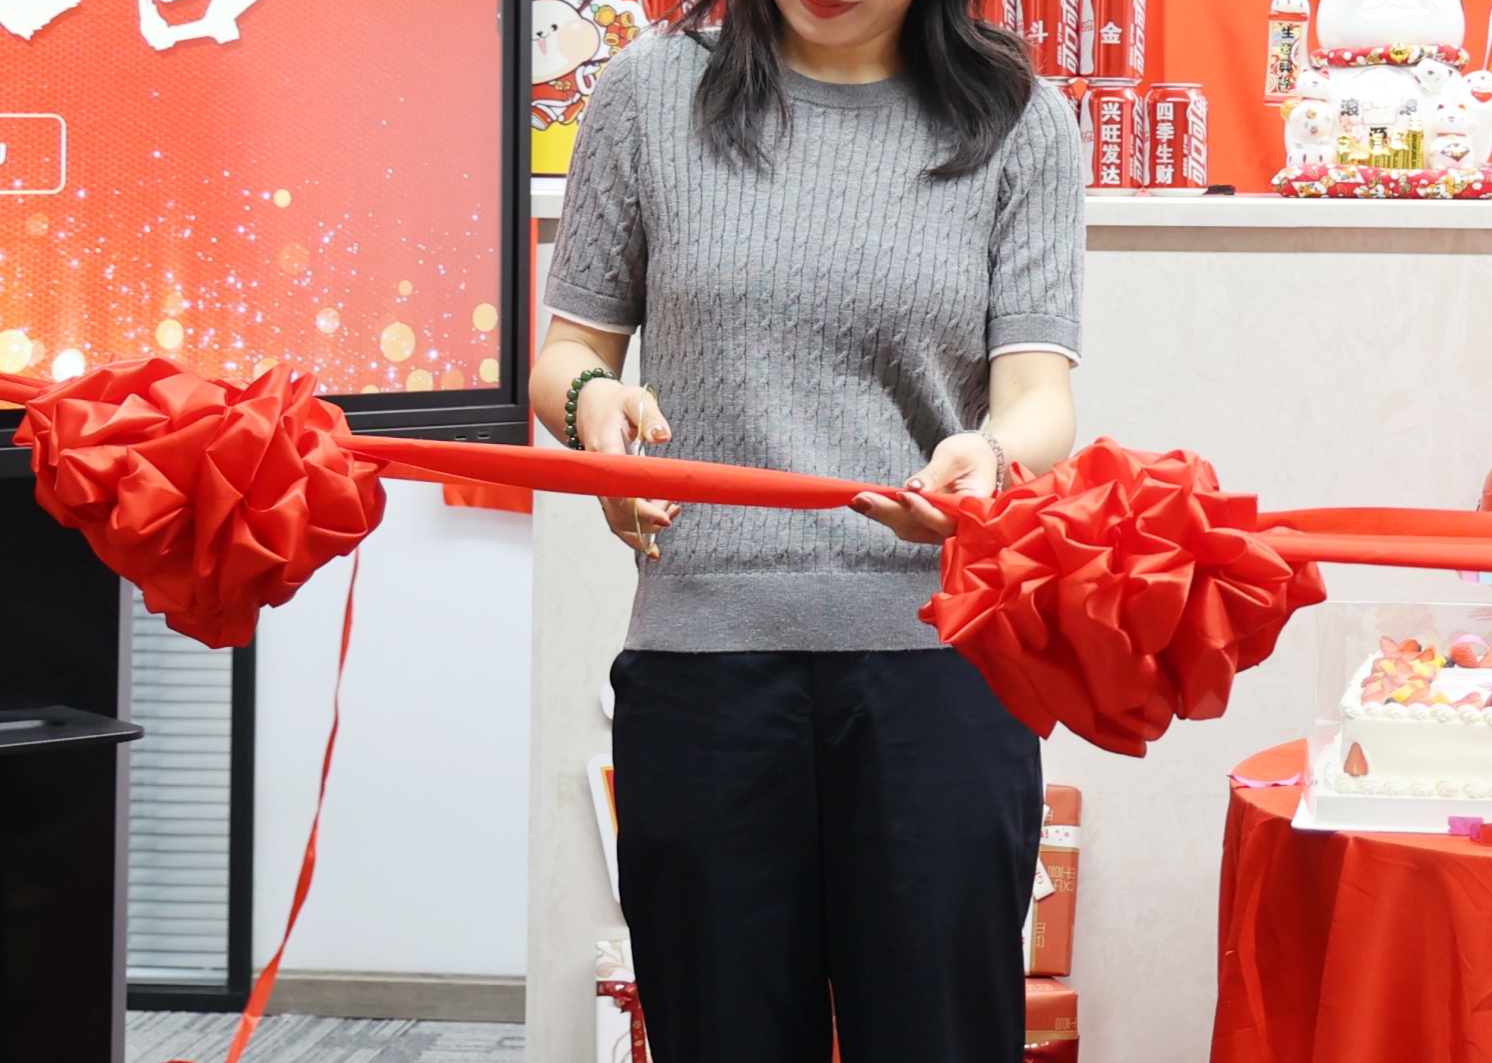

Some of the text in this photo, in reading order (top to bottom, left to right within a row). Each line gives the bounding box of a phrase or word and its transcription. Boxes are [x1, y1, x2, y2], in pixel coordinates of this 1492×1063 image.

[1027, 20, 1049, 44] 斗
[1099, 21, 1123, 45] 金
[1100, 102, 1123, 185] 兴旺发达
[1155, 102, 1175, 186] 四季生财
